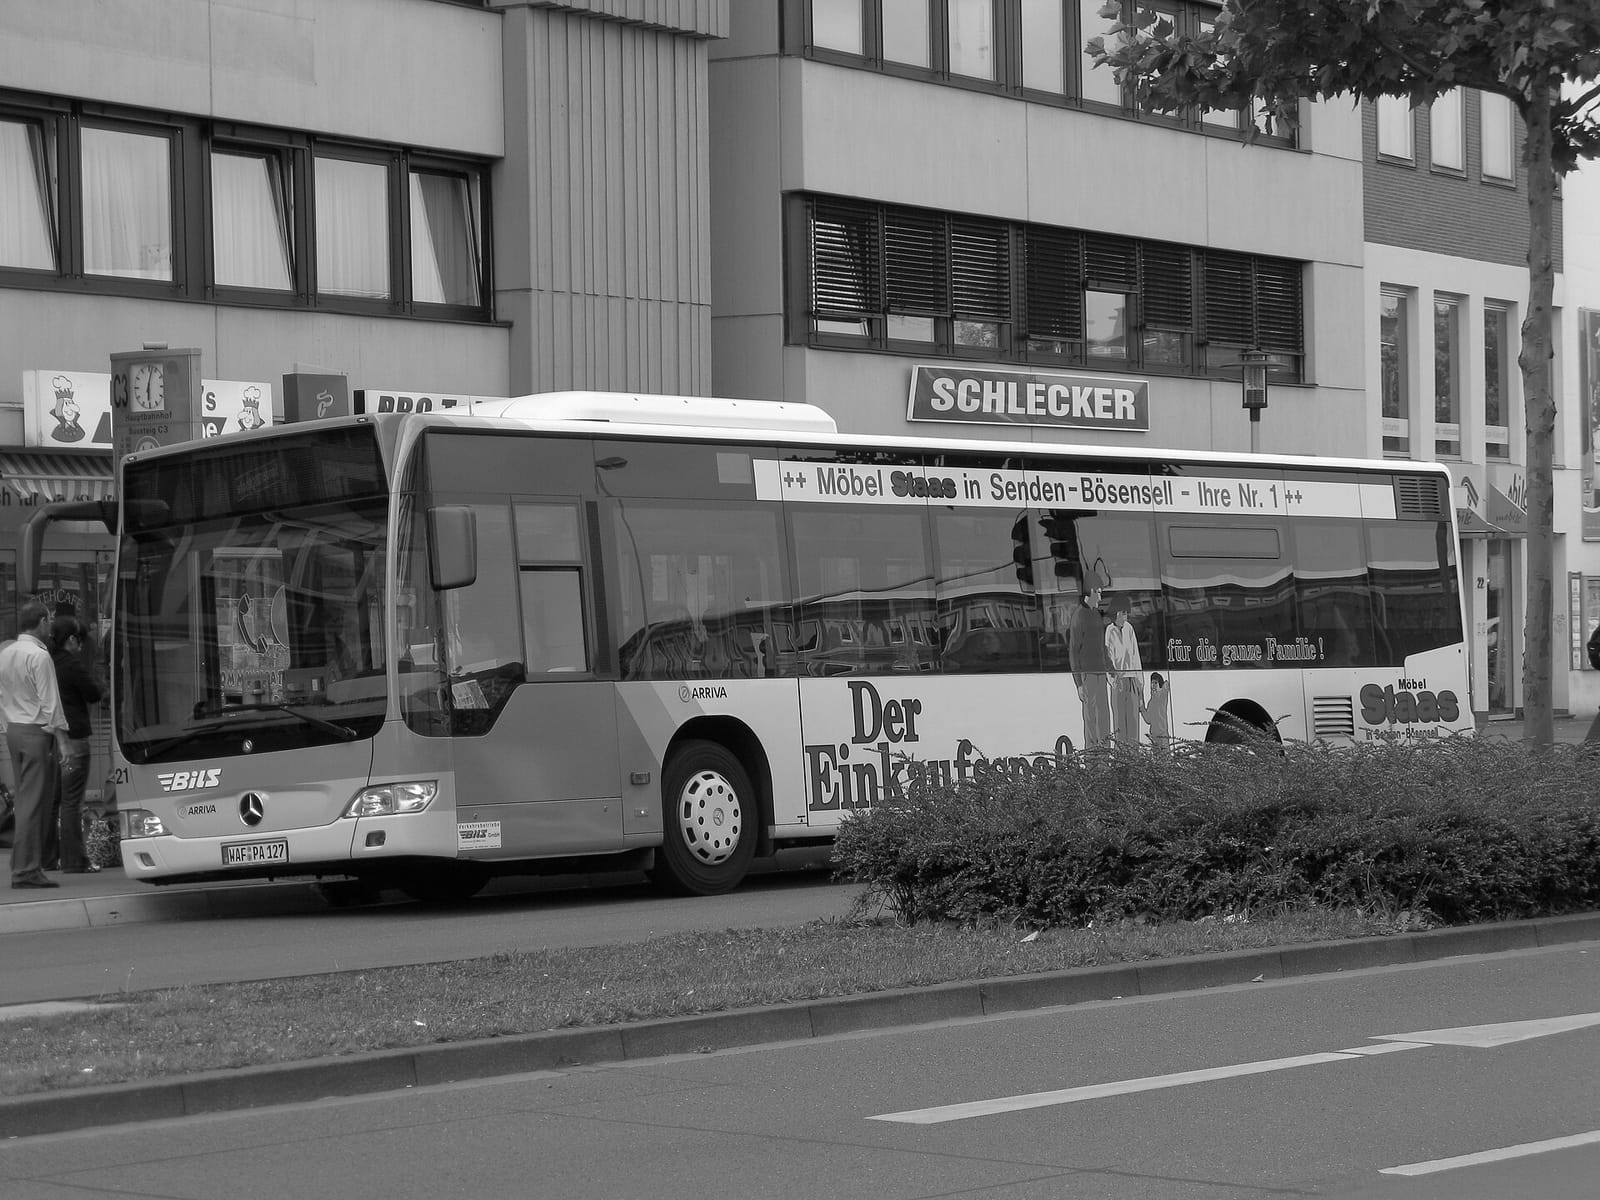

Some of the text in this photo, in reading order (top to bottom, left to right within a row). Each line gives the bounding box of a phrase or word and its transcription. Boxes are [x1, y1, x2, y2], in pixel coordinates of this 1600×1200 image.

[113, 374, 129, 408] C3
[930, 377, 1137, 421] SCHLECKER
[157, 425, 169, 434] C3
[816, 467, 884, 497] Möbel
[890, 470, 958, 499] Staas
[963, 473, 982, 500] in
[1197, 481, 1232, 507] Ihre
[1238, 482, 1264, 508] Nr.
[1269, 484, 1279, 509] 1
[1167, 638, 1191, 662] für
[1195, 638, 1218, 662] die
[1222, 643, 1263, 666] ganze
[691, 686, 728, 699] ARRIVA
[1398, 678, 1427, 690] Möbel
[847, 680, 922, 744] Der
[1360, 683, 1460, 725] Staas
[187, 804, 217, 816] ARRIVA
[228, 843, 285, 863] WAF PA 127
